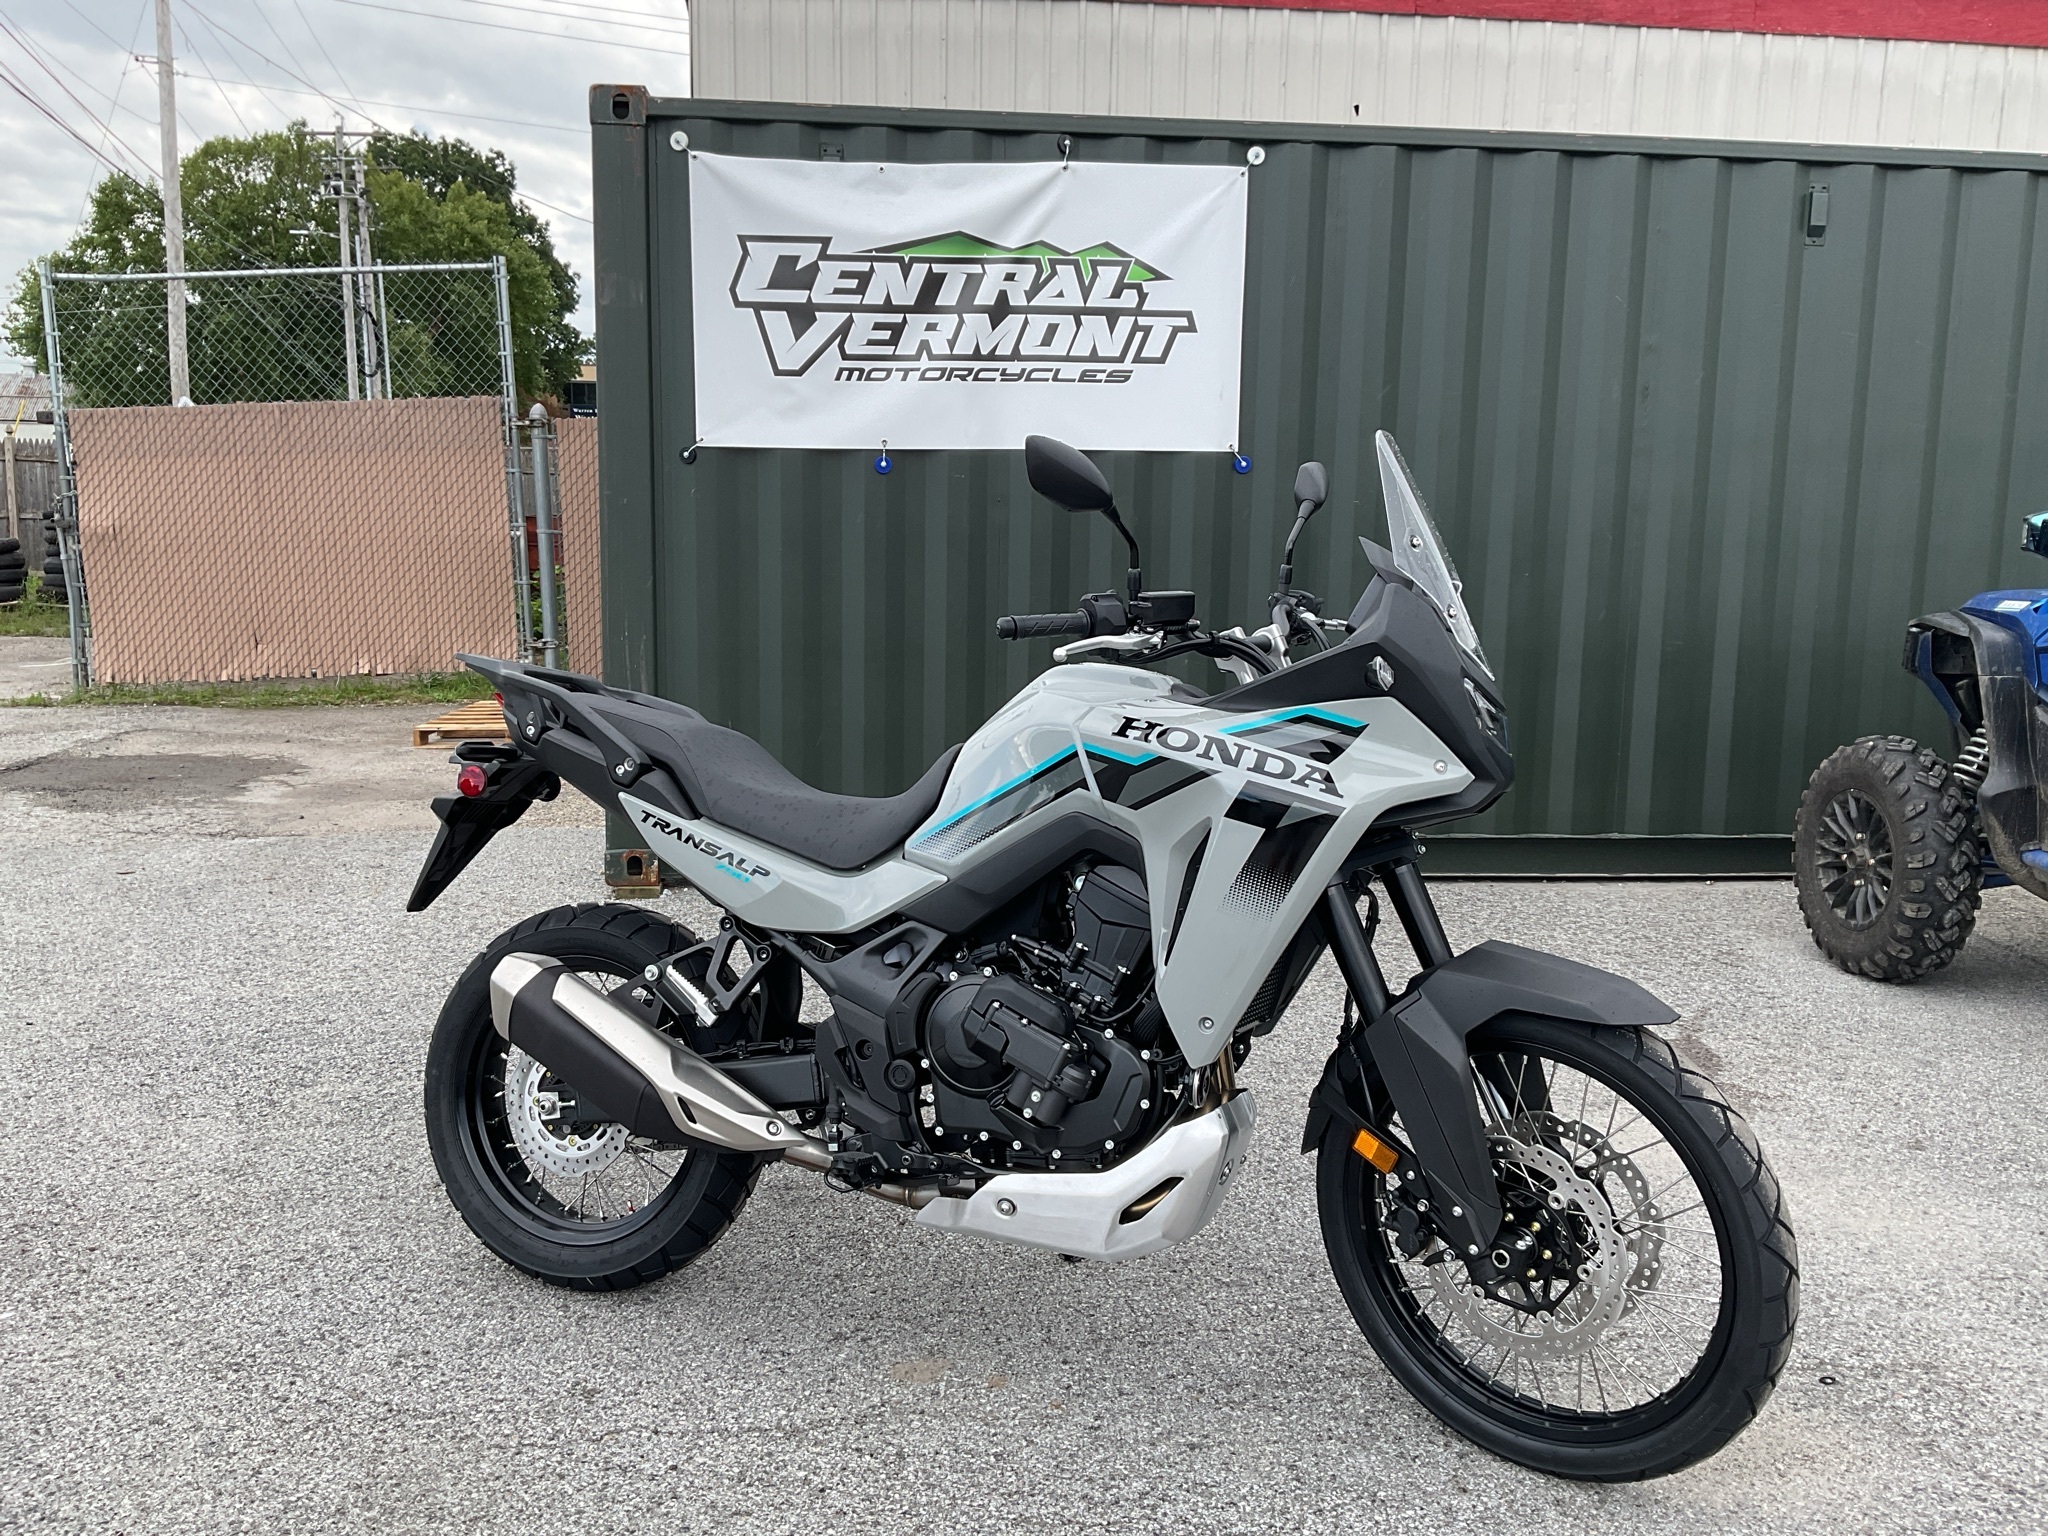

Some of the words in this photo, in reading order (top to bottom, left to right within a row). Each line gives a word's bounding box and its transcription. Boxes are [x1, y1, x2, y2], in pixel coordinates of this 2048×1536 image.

[733, 237, 1148, 308] CENTRAL
[755, 309, 1193, 374] VERMONT
[834, 366, 1134, 384] MOTORCYCLES
[1111, 715, 1344, 799] HONDA
[641, 809, 771, 878] TRANSALP
